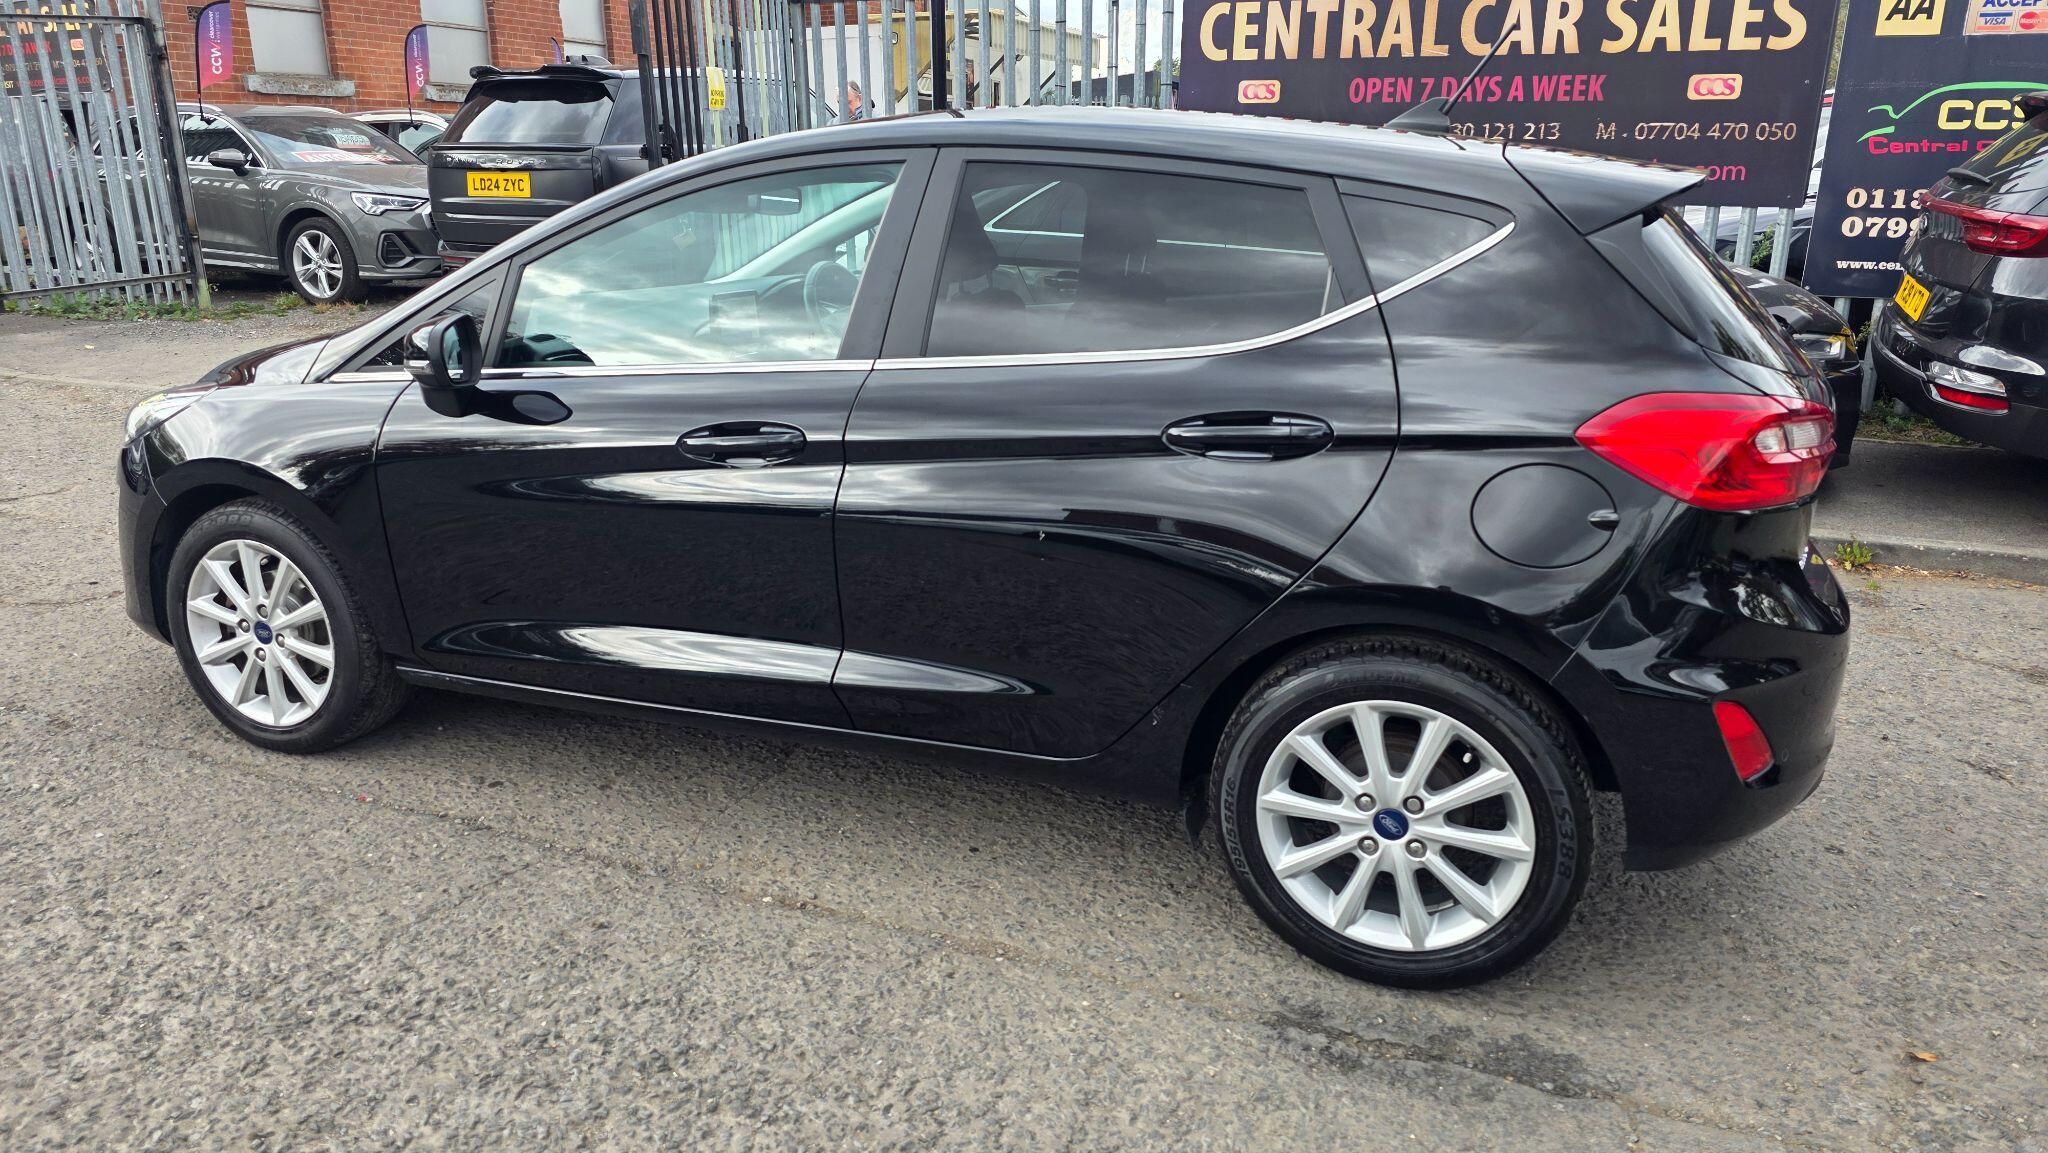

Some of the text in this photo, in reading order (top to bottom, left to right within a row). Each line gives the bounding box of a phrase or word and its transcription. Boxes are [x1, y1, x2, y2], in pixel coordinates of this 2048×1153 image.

[1885, 0, 1935, 20] AA
[1985, 17, 2007, 25] VISA
[1200, 0, 1809, 61] CENTRAL CAR SALES
[1348, 74, 1607, 104] OPEN 7 DAYS A WEEK
[1482, 122, 1514, 139] 121
[1523, 122, 1561, 140] 213
[1634, 122, 1702, 140] 07704
[1706, 122, 1750, 140] 470
[1755, 122, 1797, 141] 050
[1868, 137, 1968, 155] Central
[472, 177, 525, 192] LD24 ZYC
